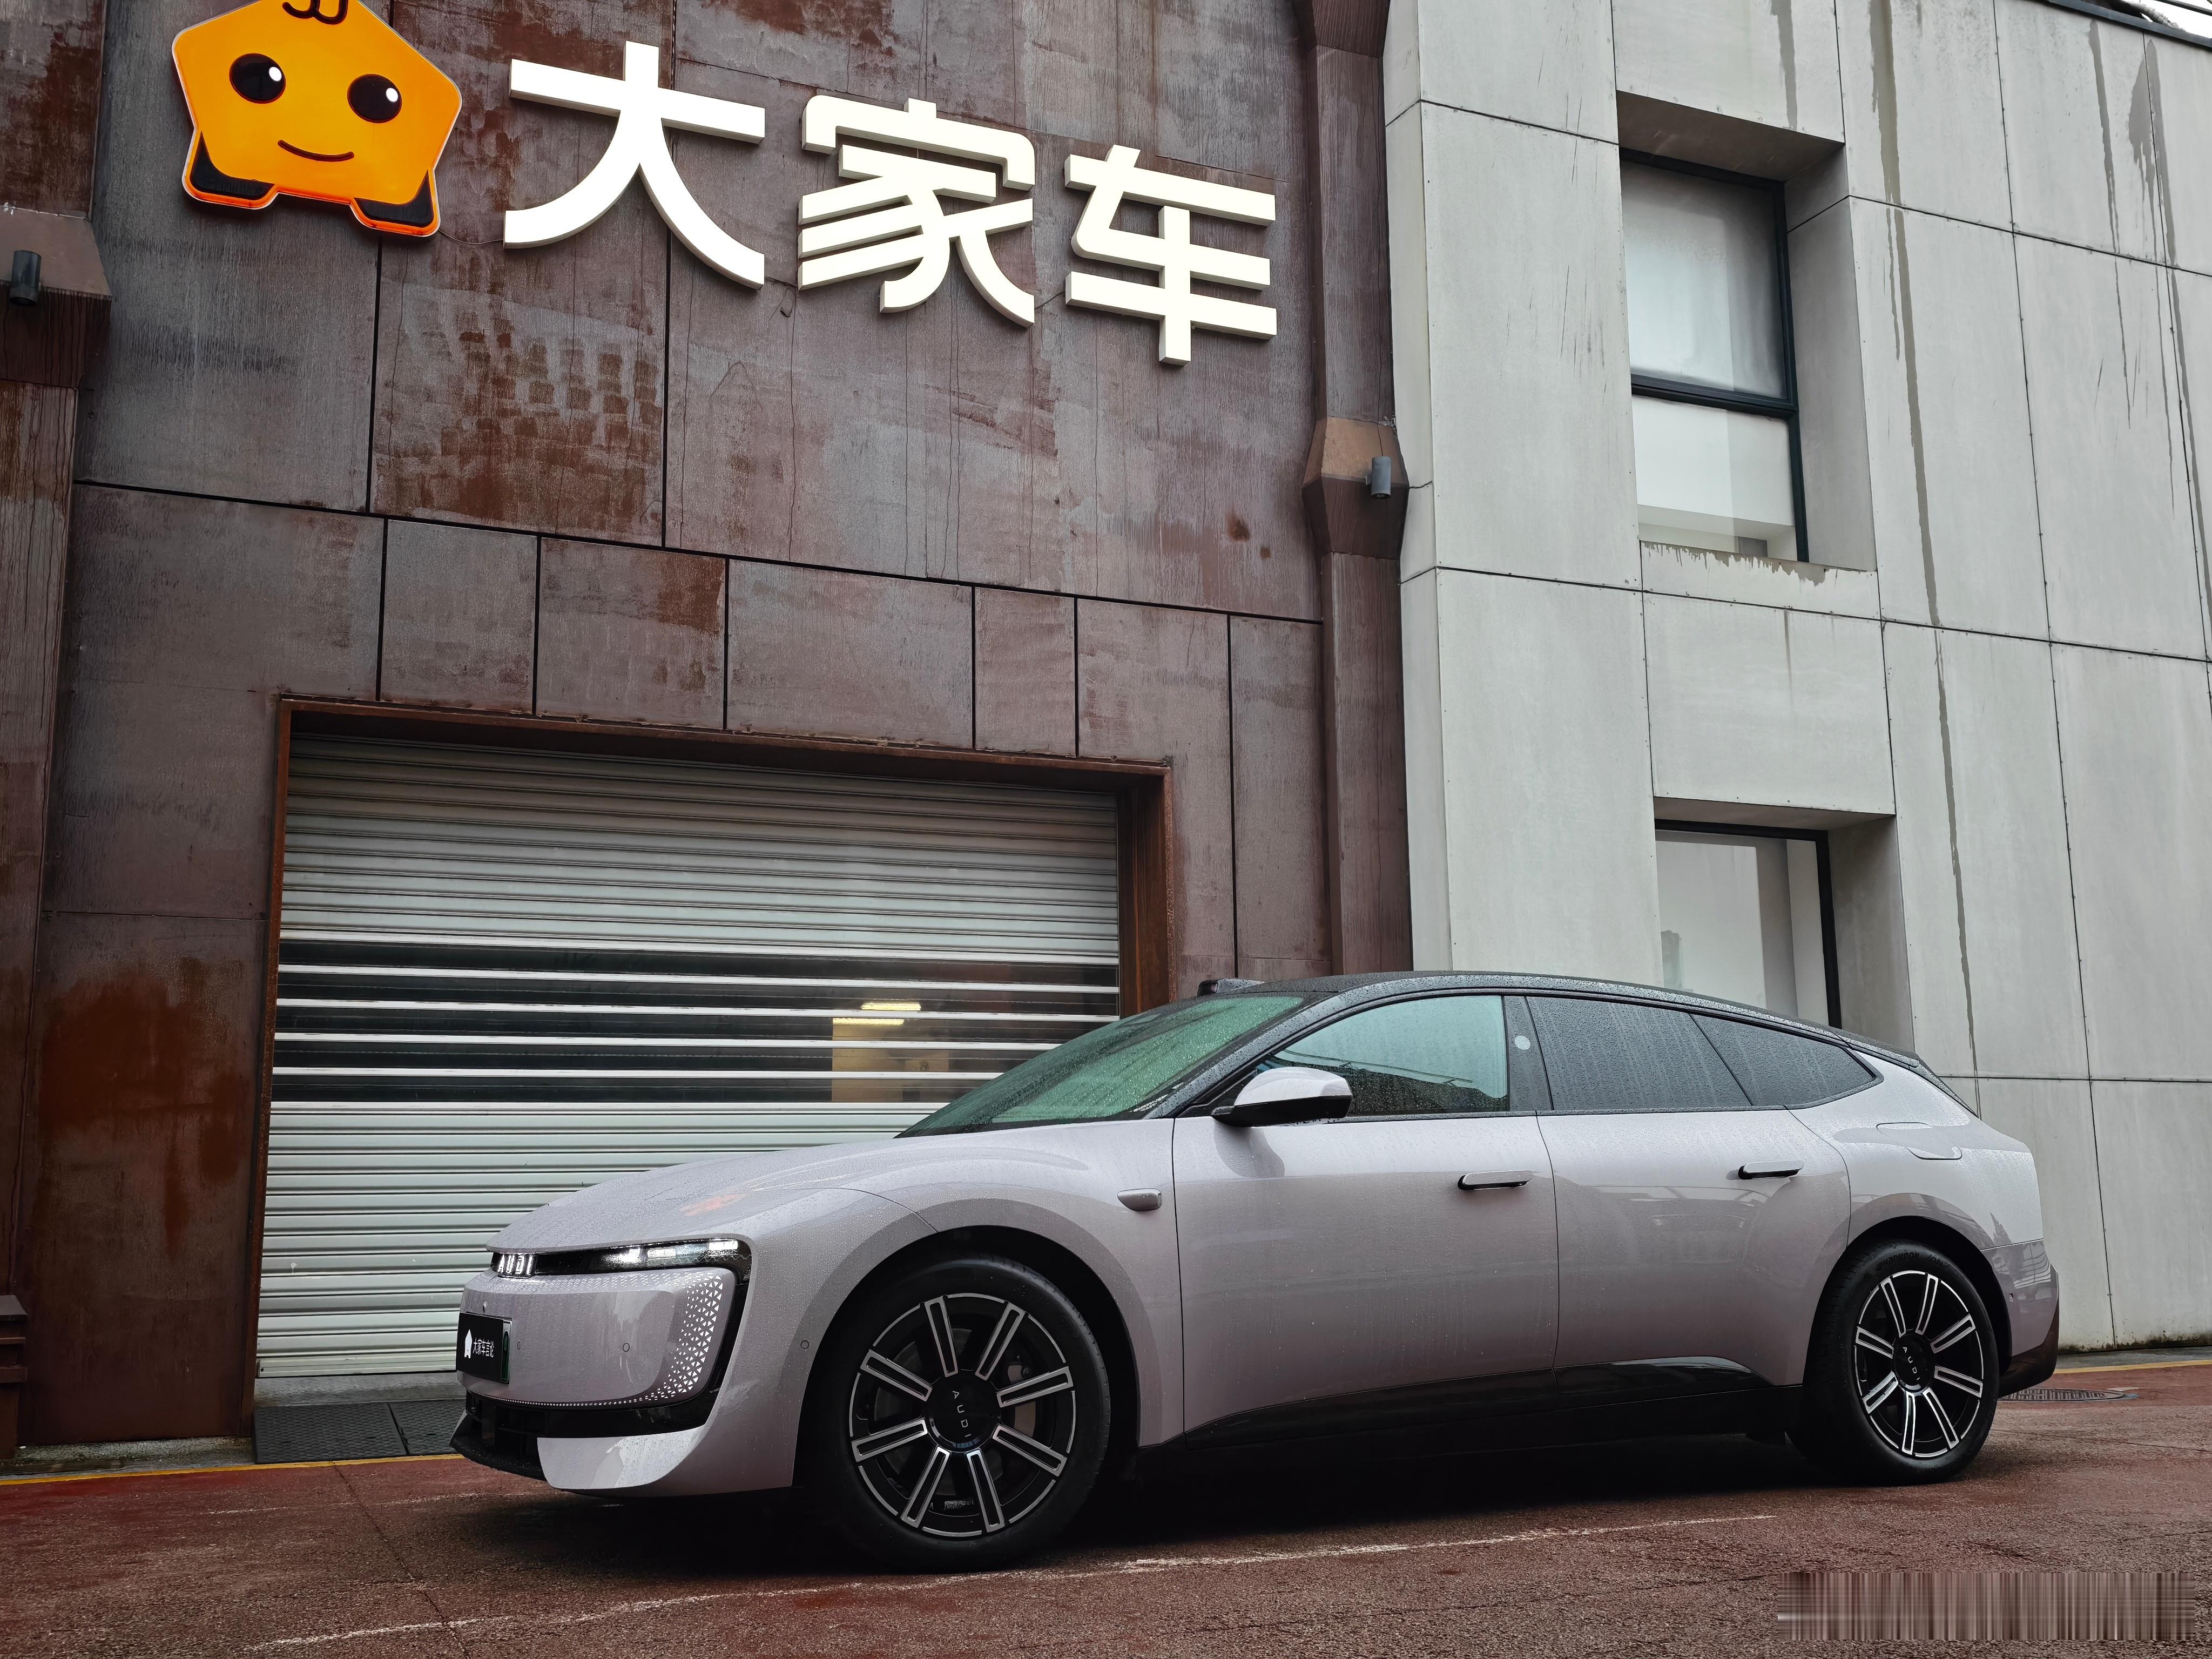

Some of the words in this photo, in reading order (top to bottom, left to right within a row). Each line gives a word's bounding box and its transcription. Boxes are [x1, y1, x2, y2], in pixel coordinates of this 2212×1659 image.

[503, 41, 1278, 366] 大家车
[497, 1254, 532, 1275] AUDI
[473, 1337, 495, 1358] 大家车言论
[1902, 1347, 1920, 1381] AUDI
[952, 1391, 972, 1438] AUDI
